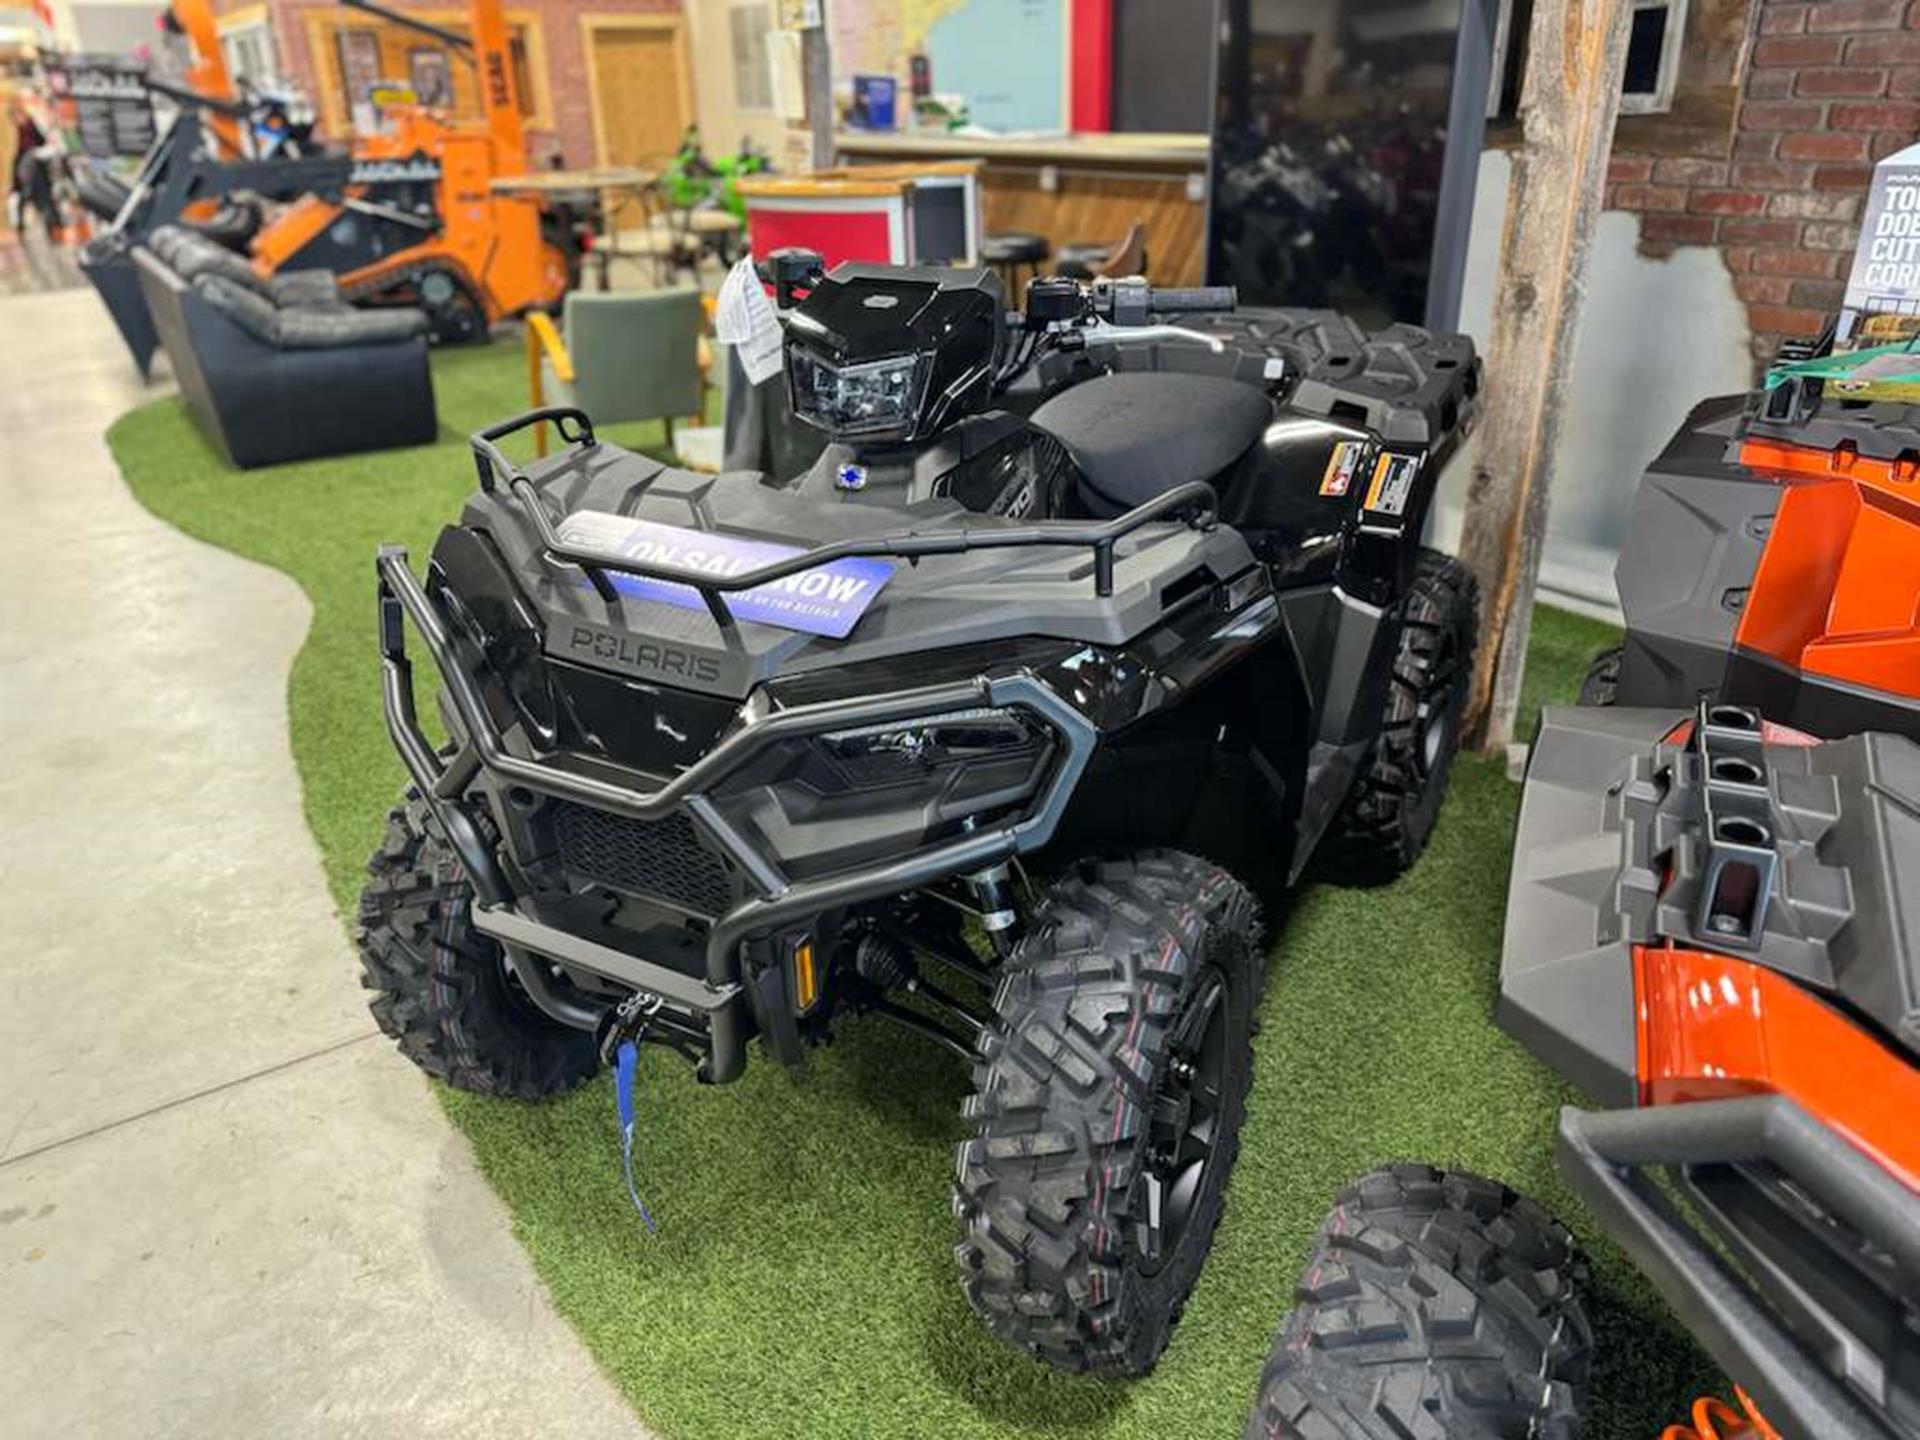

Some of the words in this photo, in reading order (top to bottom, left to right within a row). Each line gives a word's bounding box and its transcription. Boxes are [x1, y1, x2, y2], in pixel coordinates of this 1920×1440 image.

[1871, 238, 1920, 261] CUT
[682, 551, 772, 577] SAL
[569, 627, 721, 682] POLARIS
